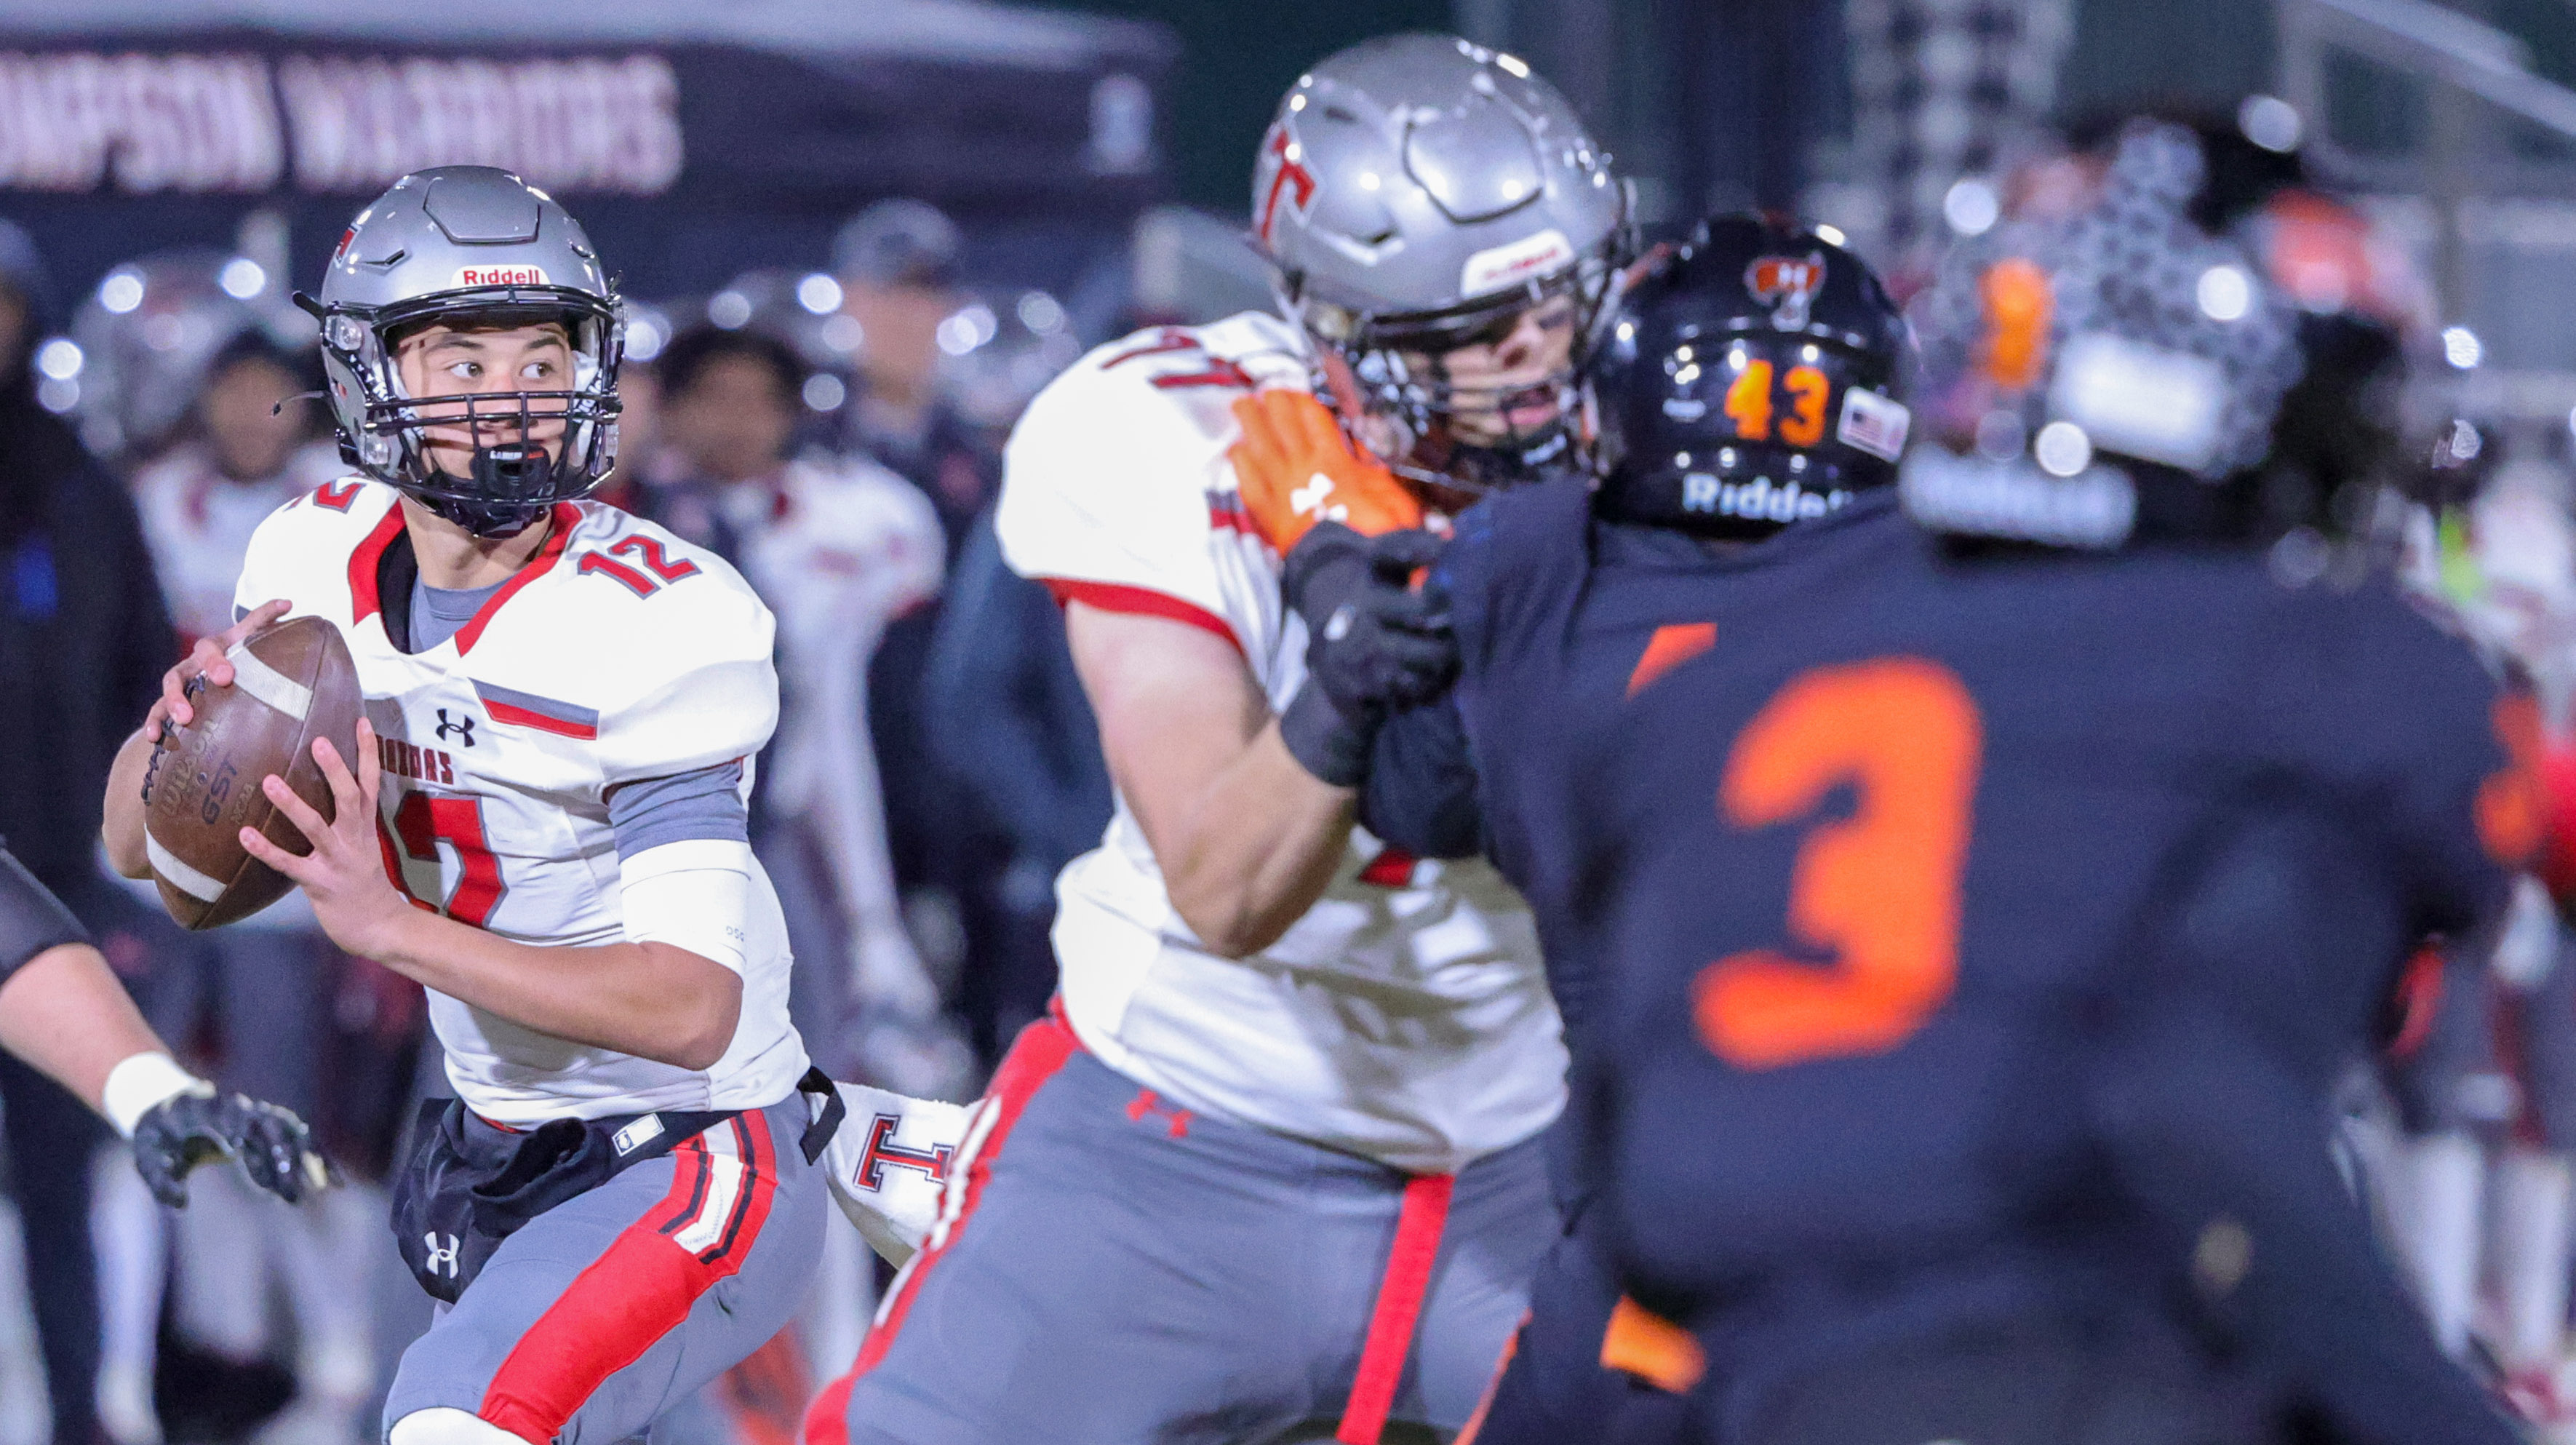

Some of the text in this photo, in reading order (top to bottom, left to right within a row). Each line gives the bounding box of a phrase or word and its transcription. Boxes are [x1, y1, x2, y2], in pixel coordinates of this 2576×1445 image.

[463, 268, 541, 285] Riddell
[1723, 359, 1831, 449] 43
[1683, 473, 1854, 523] Ridde
[577, 533, 703, 601] 12
[1691, 653, 1984, 1070] 3
[853, 1112, 955, 1193] T
